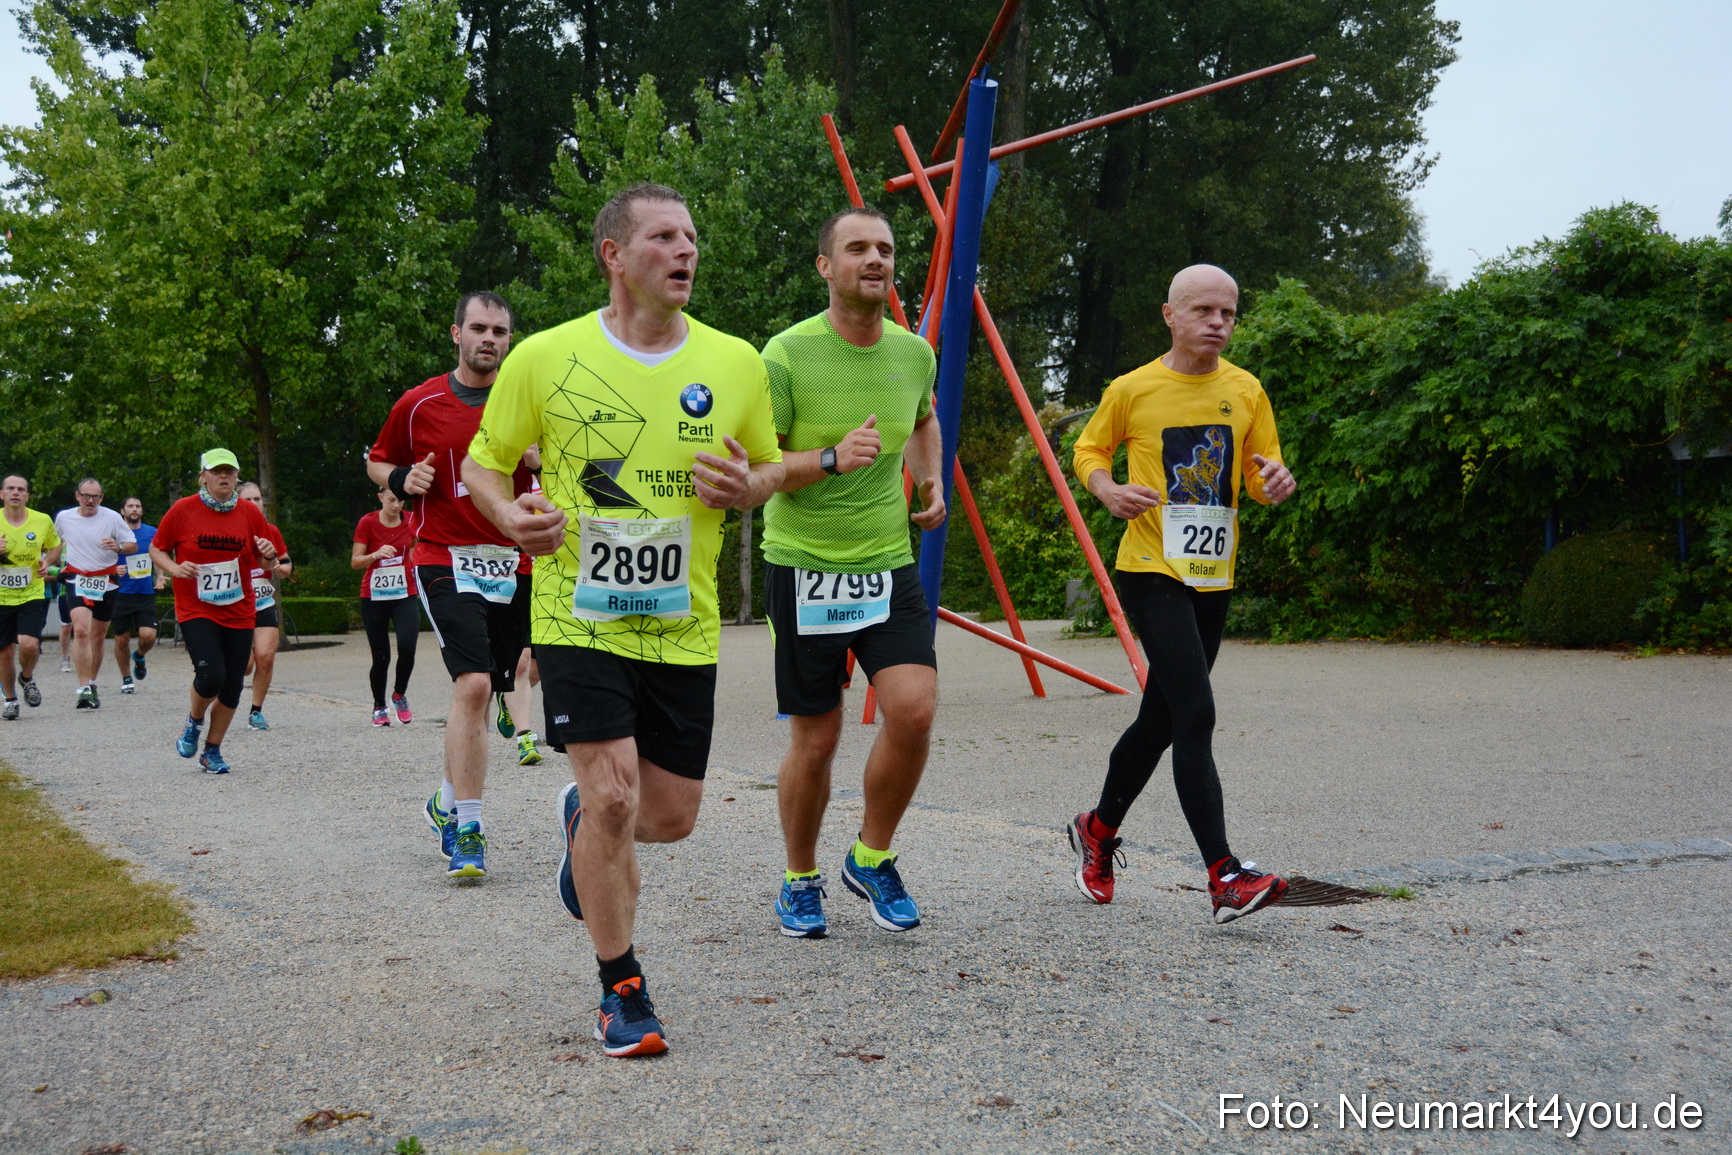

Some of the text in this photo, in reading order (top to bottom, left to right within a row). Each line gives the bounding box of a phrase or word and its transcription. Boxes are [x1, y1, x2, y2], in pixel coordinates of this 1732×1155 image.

[683, 384, 711, 397] BMW
[678, 421, 713, 437] Partl
[678, 435, 714, 444] Neumarkt
[636, 470, 695, 483] THE NEX
[650, 484, 698, 497] 100 YEA
[1202, 509, 1229, 519] BOC
[627, 522, 683, 536] BOCK
[1183, 524, 1226, 556] 226
[136, 559, 147, 569] 47
[590, 542, 682, 585] 2890
[1189, 562, 1217, 575] Roland
[1, 574, 28, 587] 2891
[79, 577, 106, 591] 2699
[202, 570, 239, 591] 2774
[374, 574, 404, 588] 2374
[806, 571, 884, 600] 2799
[213, 592, 235, 601] Andrea
[254, 585, 274, 599] 599
[608, 595, 660, 611] Rainer
[827, 609, 864, 621] Marco
